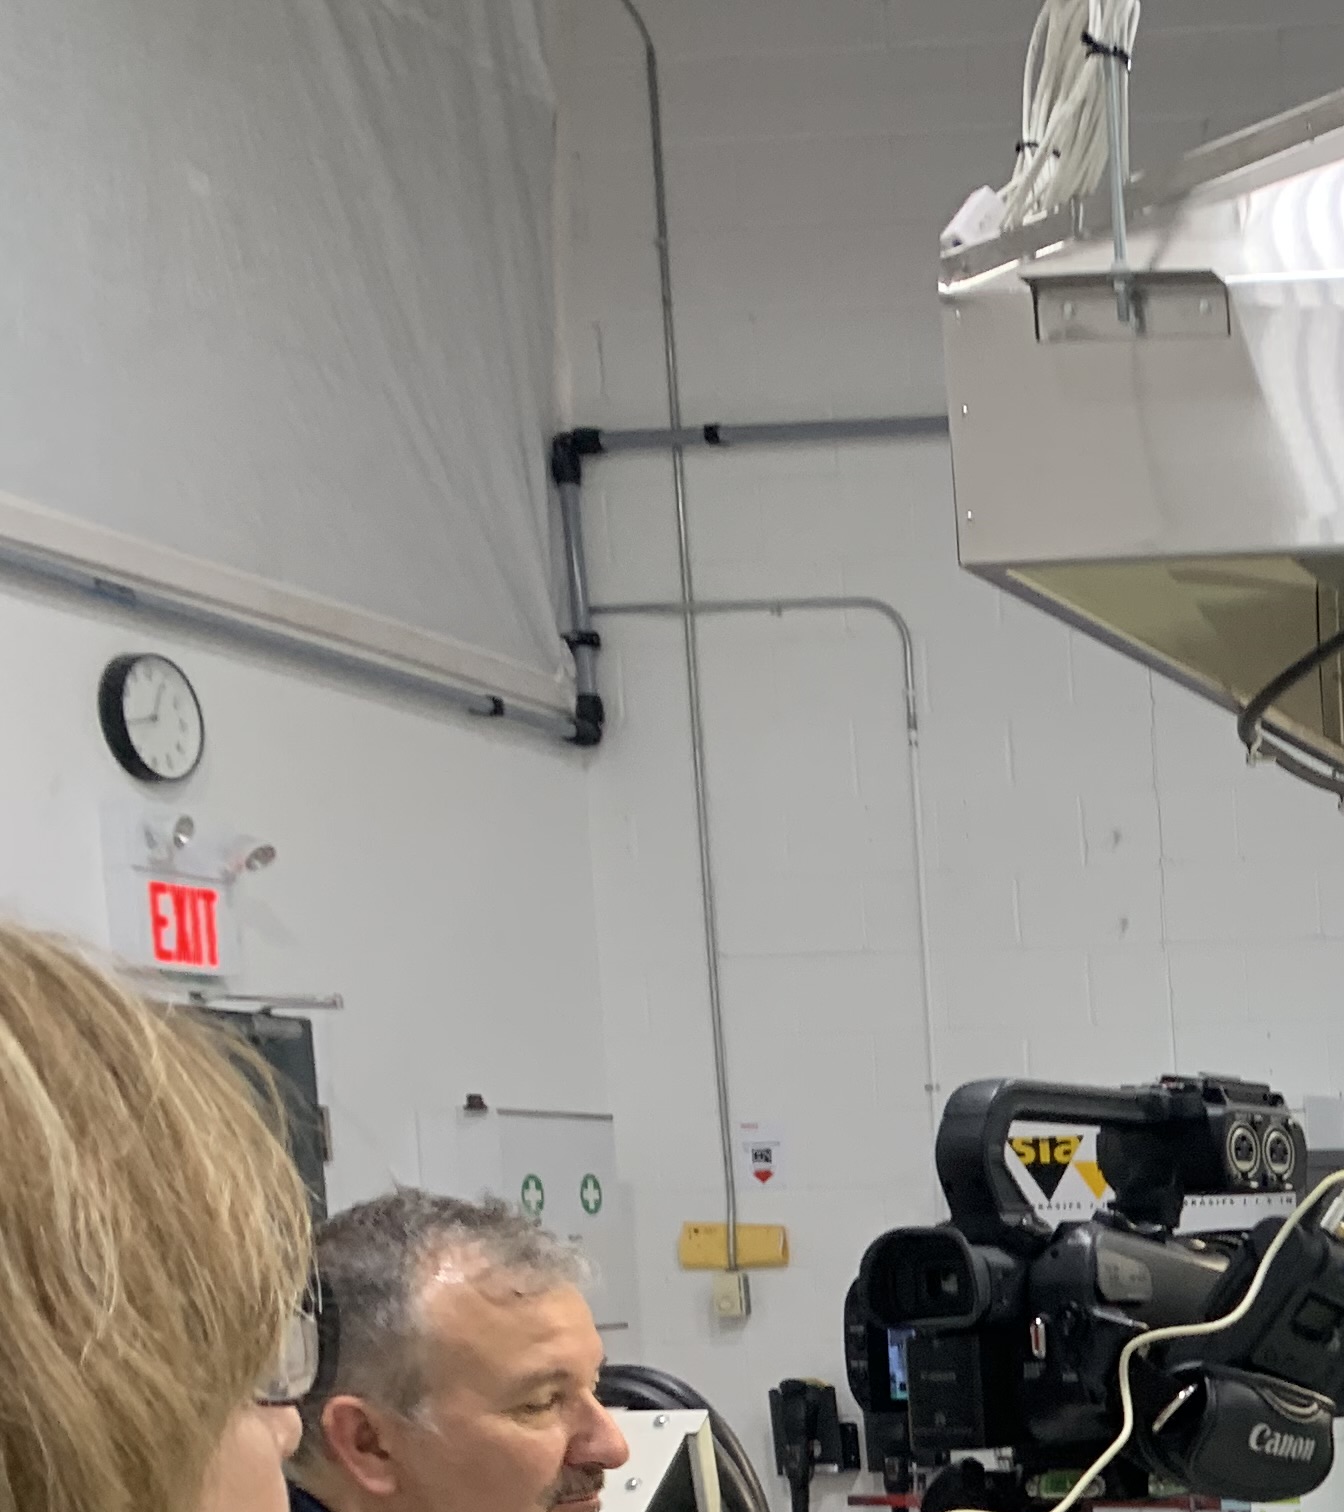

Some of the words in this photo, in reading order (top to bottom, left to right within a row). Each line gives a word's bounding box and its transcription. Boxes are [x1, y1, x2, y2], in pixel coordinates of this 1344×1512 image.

[149, 881, 217, 966] EXIT
[1009, 1135, 1081, 1165] sia
[1249, 1422, 1316, 1464] Canon
